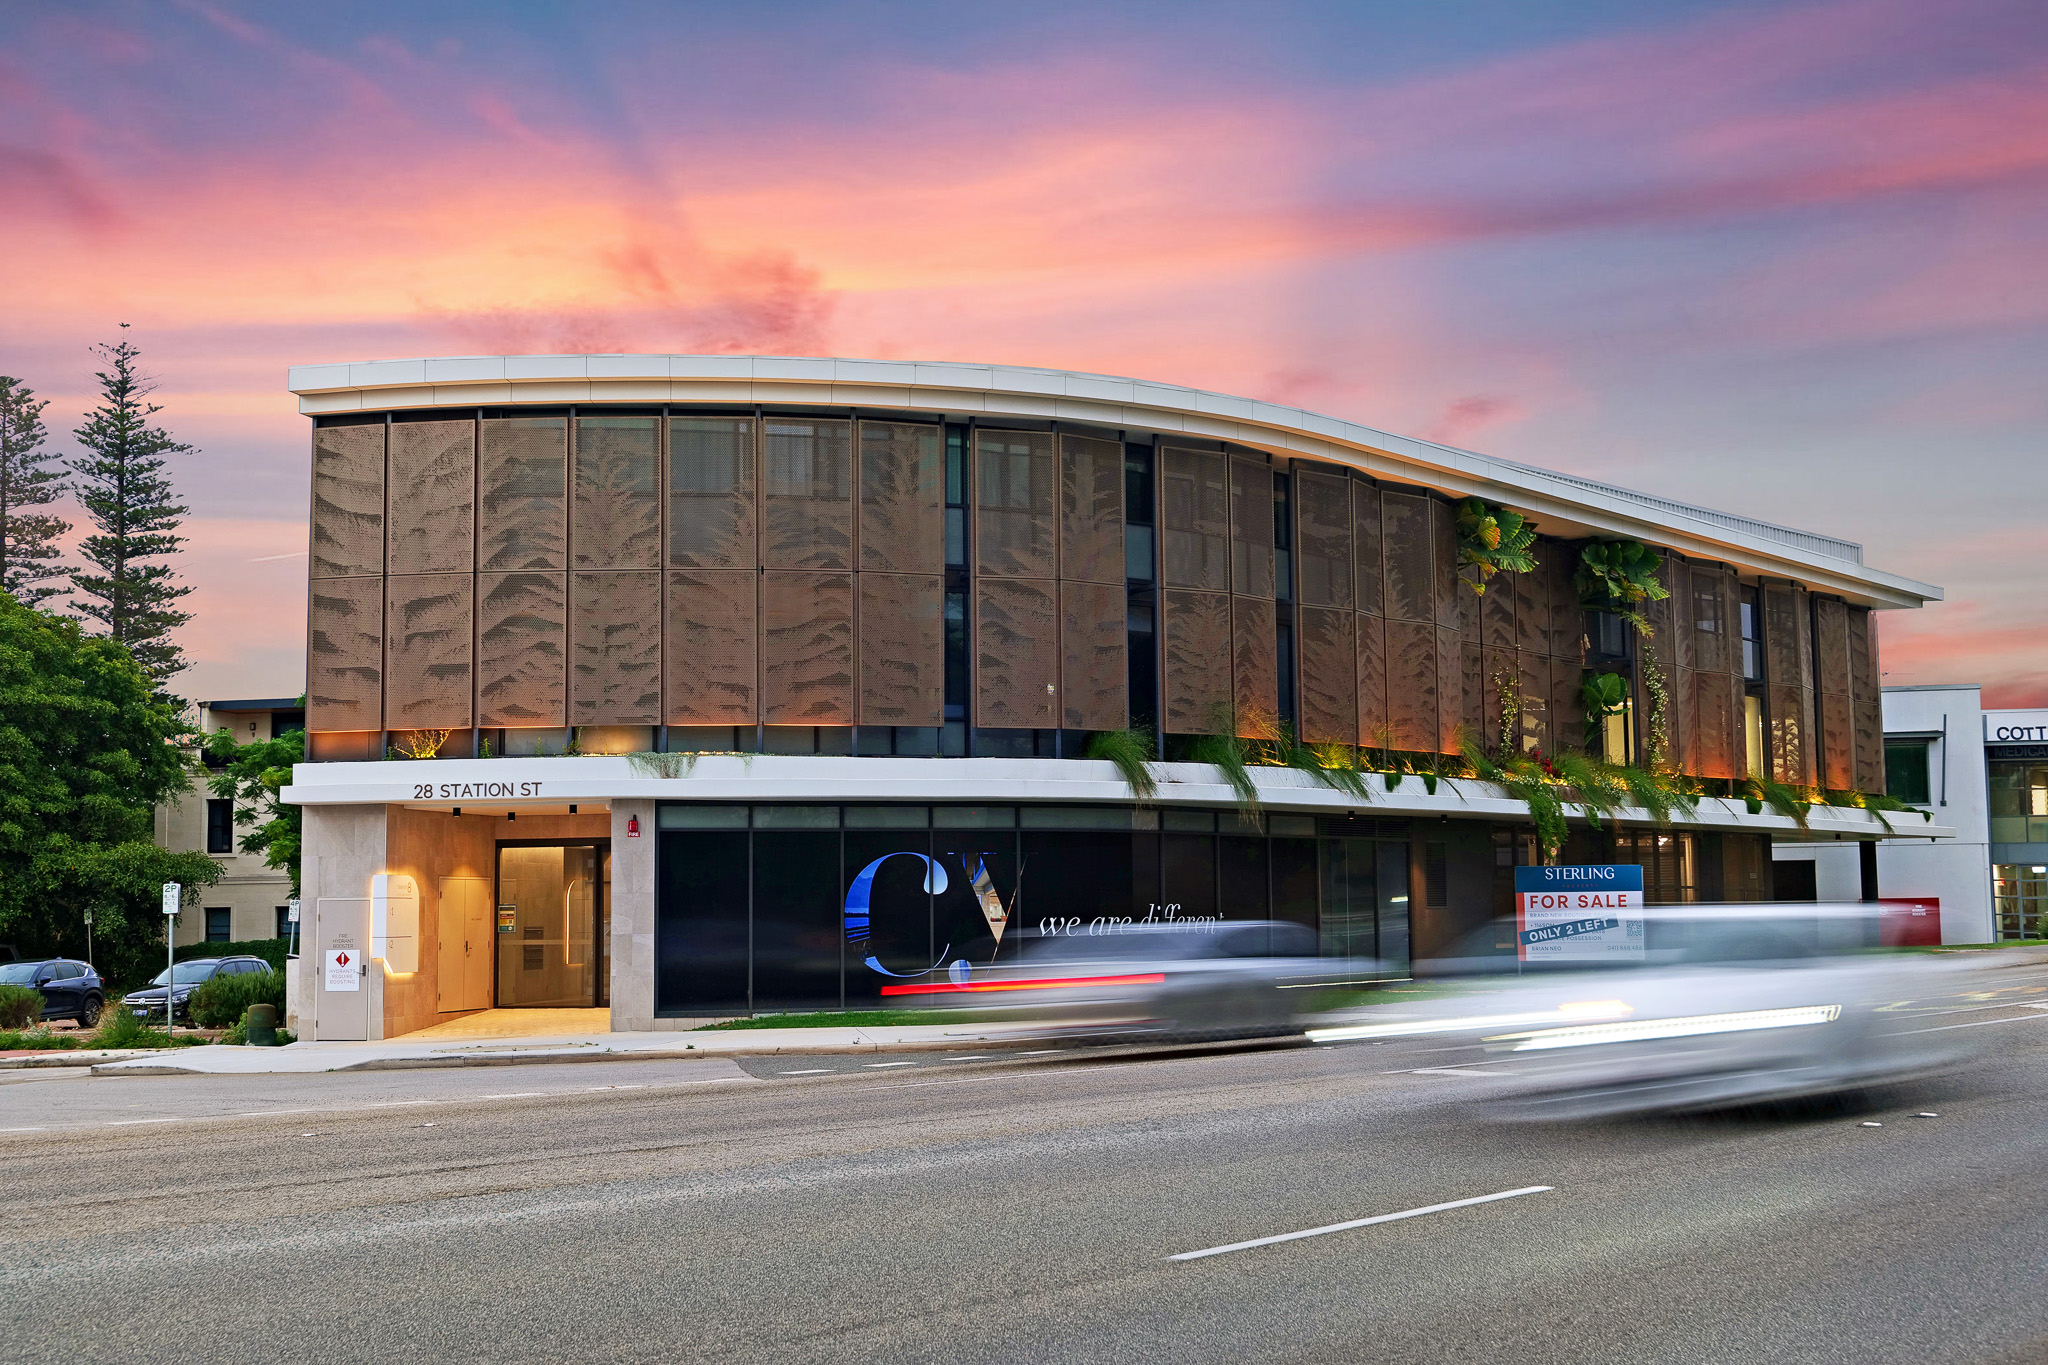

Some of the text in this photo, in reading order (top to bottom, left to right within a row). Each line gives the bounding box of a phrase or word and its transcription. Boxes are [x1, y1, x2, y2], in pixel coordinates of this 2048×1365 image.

[1995, 745, 2048, 757] MEDICA
[413, 782, 543, 799] 28 STATION ST
[1545, 867, 1615, 880] STERLING
[164, 885, 177, 893] 2P
[1530, 894, 1628, 909] FOR SALE
[1039, 915, 1081, 938] we
[1088, 915, 1132, 937] are
[1529, 918, 1608, 941] ONLY 2 LEFT
